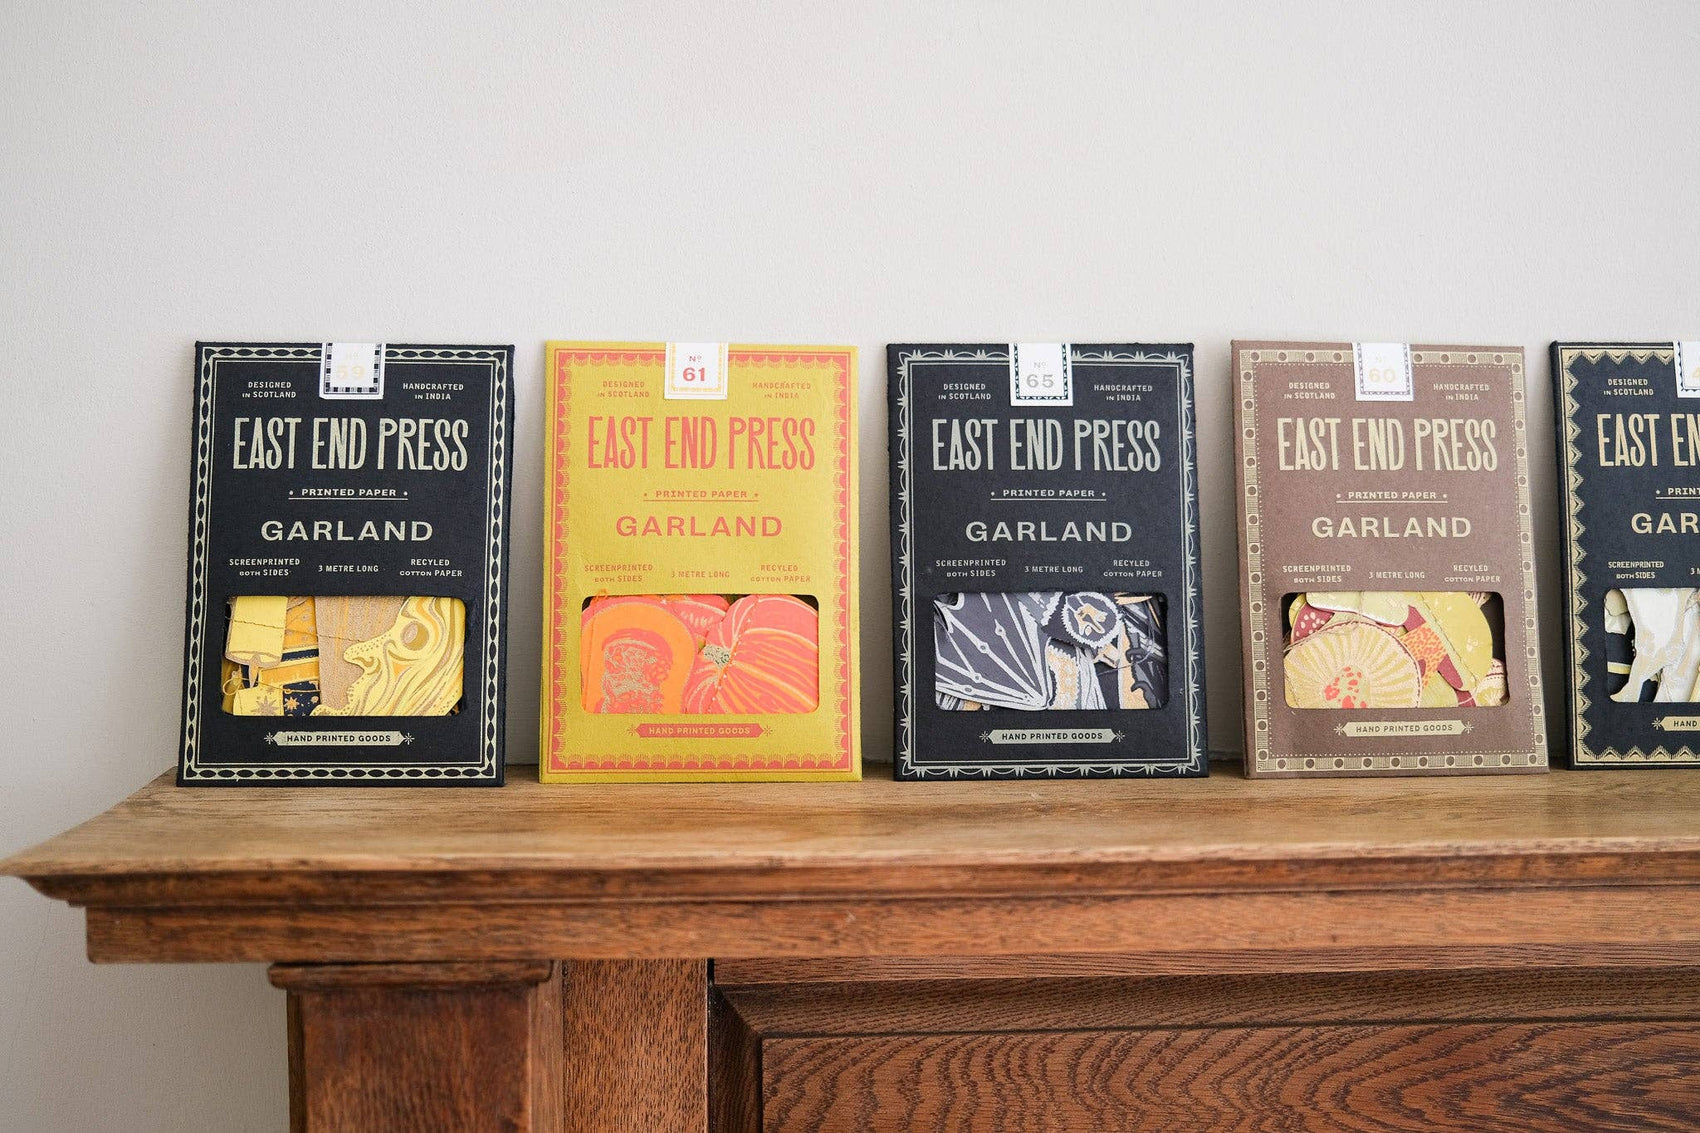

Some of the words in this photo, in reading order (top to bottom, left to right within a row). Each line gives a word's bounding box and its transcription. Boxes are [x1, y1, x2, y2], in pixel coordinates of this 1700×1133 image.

[682, 367, 707, 382] 61
[248, 381, 292, 389] DESIGNED
[1026, 374, 1054, 388] 65
[1607, 378, 1648, 386] DESIGNED
[402, 383, 464, 391] HANDCRAFTED
[752, 382, 811, 390] HANDCRAFTED
[943, 383, 986, 391] DESIGNED
[1093, 384, 1153, 392] HANDCRAFTED
[1289, 382, 1330, 390] DESIGNED
[1433, 383, 1490, 391] HANDCRAFTED
[607, 390, 650, 398] SCOTLAND
[948, 392, 991, 400] SCOTLAND
[1613, 388, 1654, 396] SCOTLAND
[425, 392, 451, 401] INDIA
[1455, 393, 1479, 401] INDIA
[233, 417, 302, 469] EAST
[311, 417, 367, 470] END
[377, 418, 469, 471] PRESS
[587, 416, 653, 468] EAST
[664, 416, 717, 469] END
[728, 417, 816, 470] PRESS
[1596, 413, 1660, 467] EAST
[932, 419, 998, 471] EAST
[1009, 419, 1063, 471] END
[1073, 419, 1161, 472] PRESS
[1276, 418, 1341, 471] EAST
[1352, 418, 1405, 471] END
[1413, 419, 1498, 472] PRESS
[301, 488, 355, 496] PRINTED
[655, 490, 707, 498] PRINTED
[711, 490, 748, 498] PAPER
[1003, 489, 1055, 497] PRINTED
[1348, 491, 1398, 499] PRINTED
[1402, 491, 1437, 499] PAPER
[261, 520, 433, 541] GARLAND
[615, 516, 782, 537] GARLAND
[1311, 517, 1471, 538] GARLAND
[965, 521, 1132, 542] GARLAND
[229, 558, 300, 566] SCREENPRINTED
[410, 558, 450, 566] RECYLED
[935, 558, 1006, 567] SCREENPRINTED
[357, 565, 379, 573] LONG
[584, 563, 653, 572] SCREENPRINTED
[760, 564, 798, 572] RECYLED
[1031, 565, 1059, 573] METRE
[1061, 565, 1083, 573] LONG
[1282, 564, 1351, 573] SCREENPRINTED
[1453, 564, 1488, 572] RECYLED
[263, 568, 289, 576] SIDES
[434, 569, 463, 577] PAPER
[678, 570, 706, 578] METRE
[708, 570, 730, 578] LONG
[970, 569, 996, 577] SIDES
[1368, 571, 1374, 579] 3
[1375, 571, 1403, 579] METRE
[1404, 571, 1425, 579] LONG
[1635, 571, 1656, 579] SIDES
[617, 574, 643, 582] SIDES
[783, 575, 811, 583] PAPER
[1316, 575, 1342, 583] SIDES
[1475, 575, 1500, 583] PAPER
[677, 727, 716, 735] PRINTED
[718, 727, 750, 735] GOODS
[1355, 725, 1379, 733] HAND
[1382, 725, 1421, 733] PRINTED
[1422, 724, 1453, 732] GOODS
[315, 734, 355, 742] PRINTED
[358, 734, 391, 742] GOODS
[1001, 733, 1028, 741] HAND
[1030, 732, 1068, 740] PRINTED
[1071, 732, 1103, 740] GOODS
